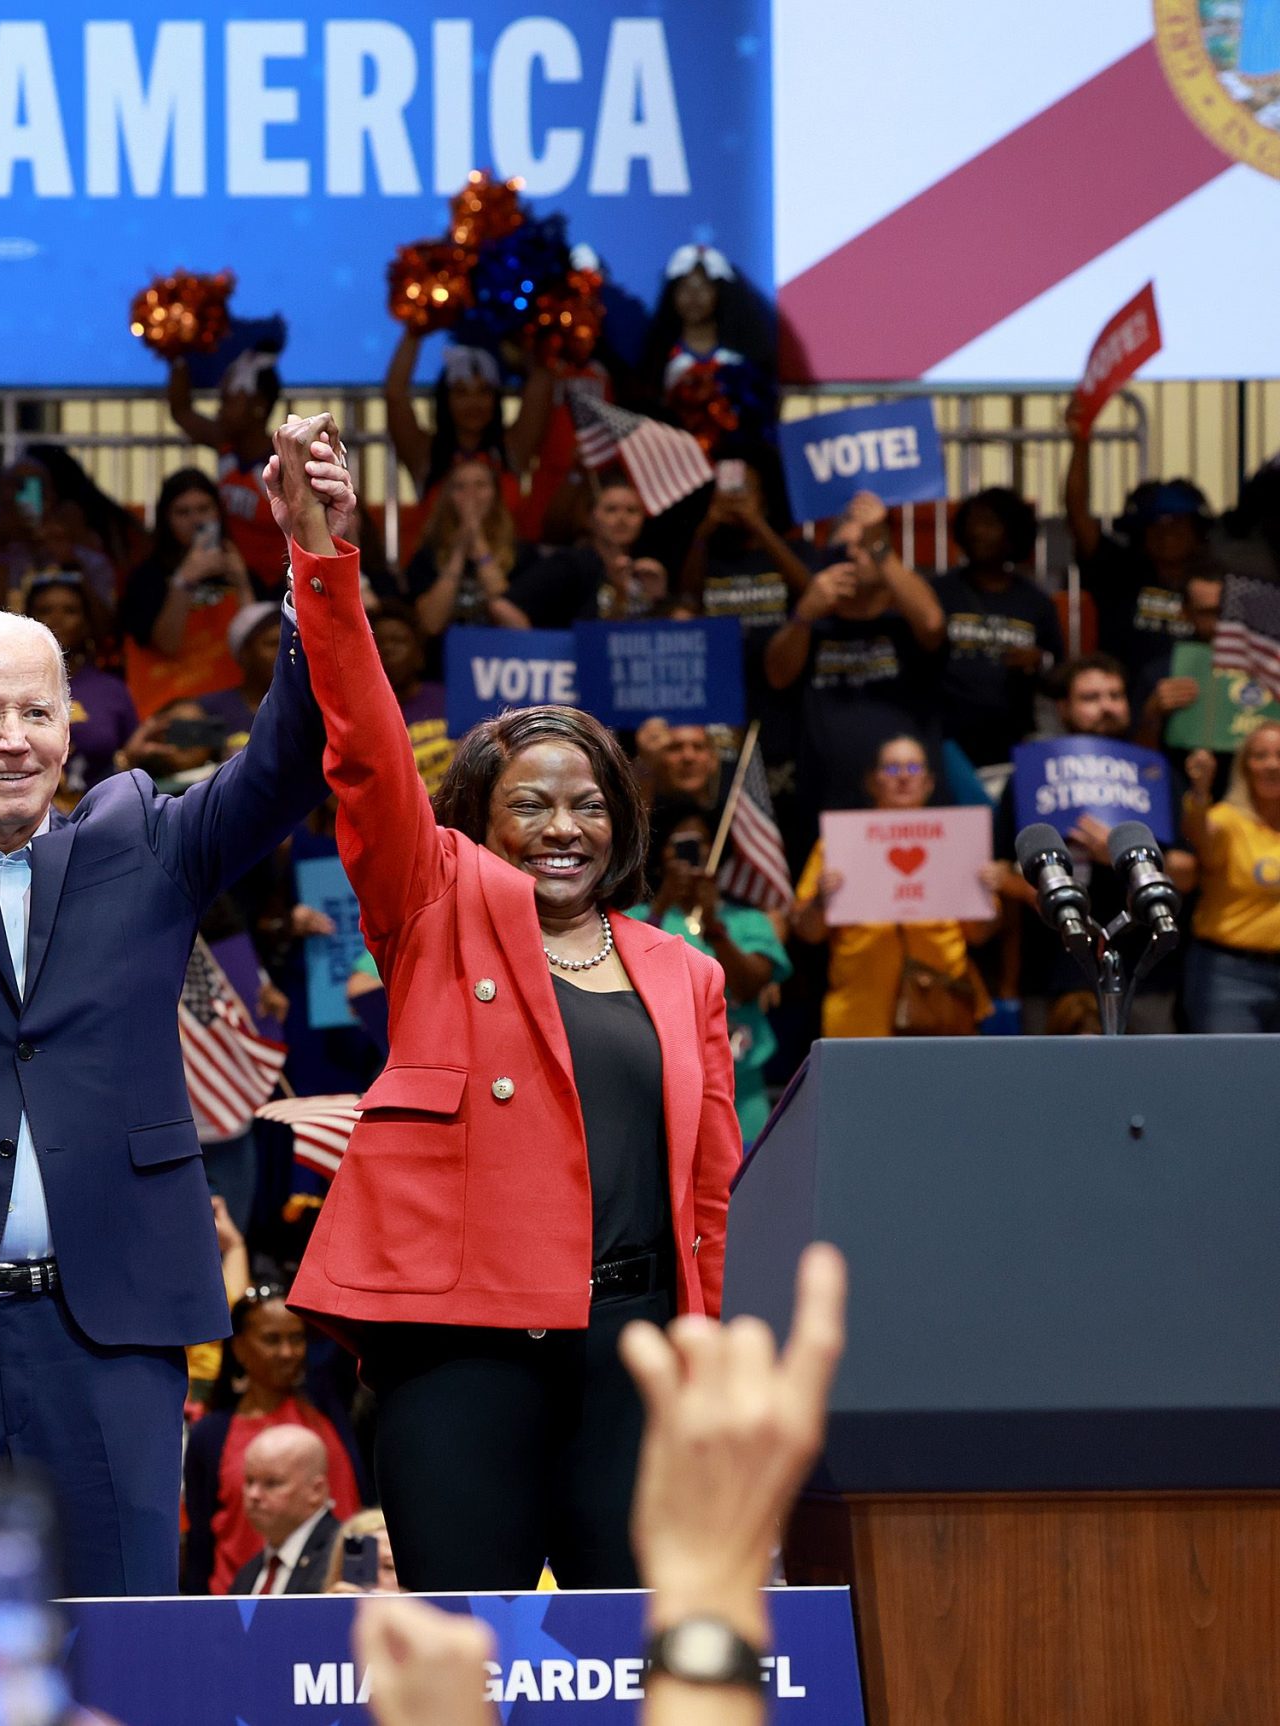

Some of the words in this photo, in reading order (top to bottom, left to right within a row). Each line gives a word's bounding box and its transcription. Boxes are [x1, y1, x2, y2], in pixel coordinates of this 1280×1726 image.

[804, 426, 920, 483] VOTE!
[1045, 754, 1138, 785] UNION
[1036, 780, 1151, 815] STRONG
[482, 1658, 652, 1702] GARDE
